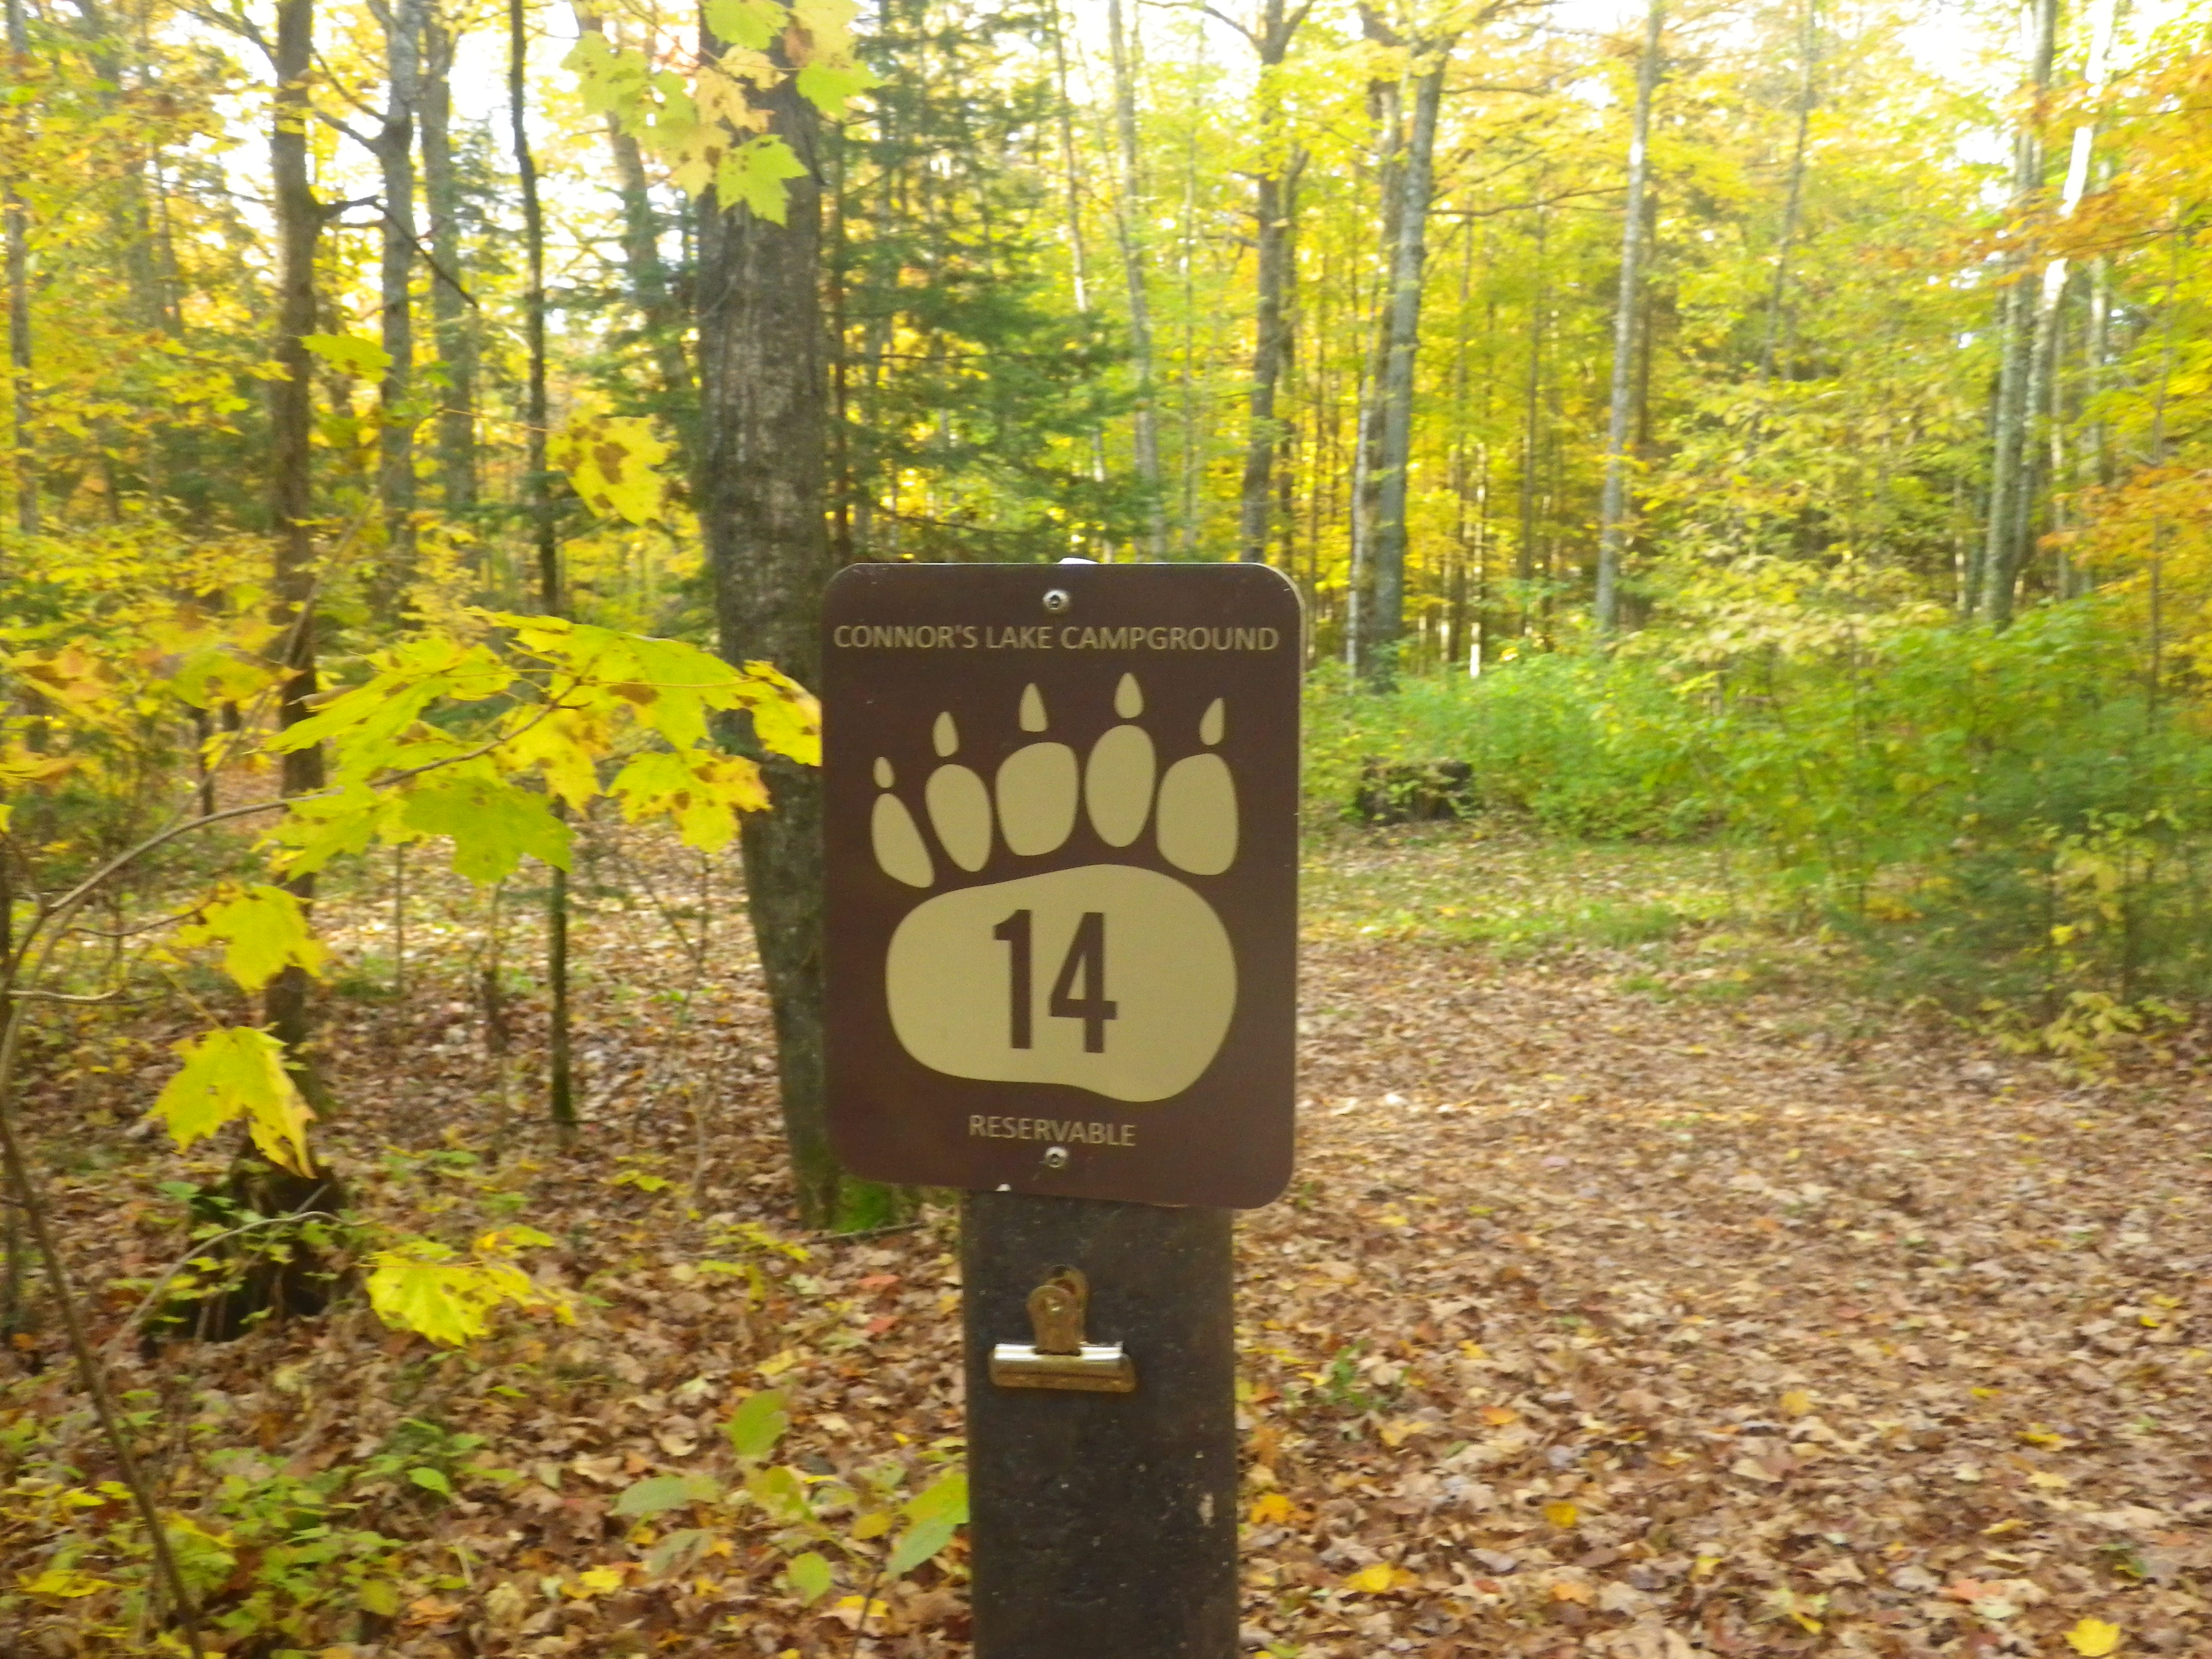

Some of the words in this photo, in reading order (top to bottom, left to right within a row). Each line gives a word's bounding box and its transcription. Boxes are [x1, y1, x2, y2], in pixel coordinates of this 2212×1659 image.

[834, 624, 977, 649] CONNOR'S
[985, 625, 1053, 649] LAKE
[1060, 625, 1279, 651] CAMPGROUND
[993, 908, 1118, 1053] 14
[969, 1114, 1136, 1147] RESERVABLE
